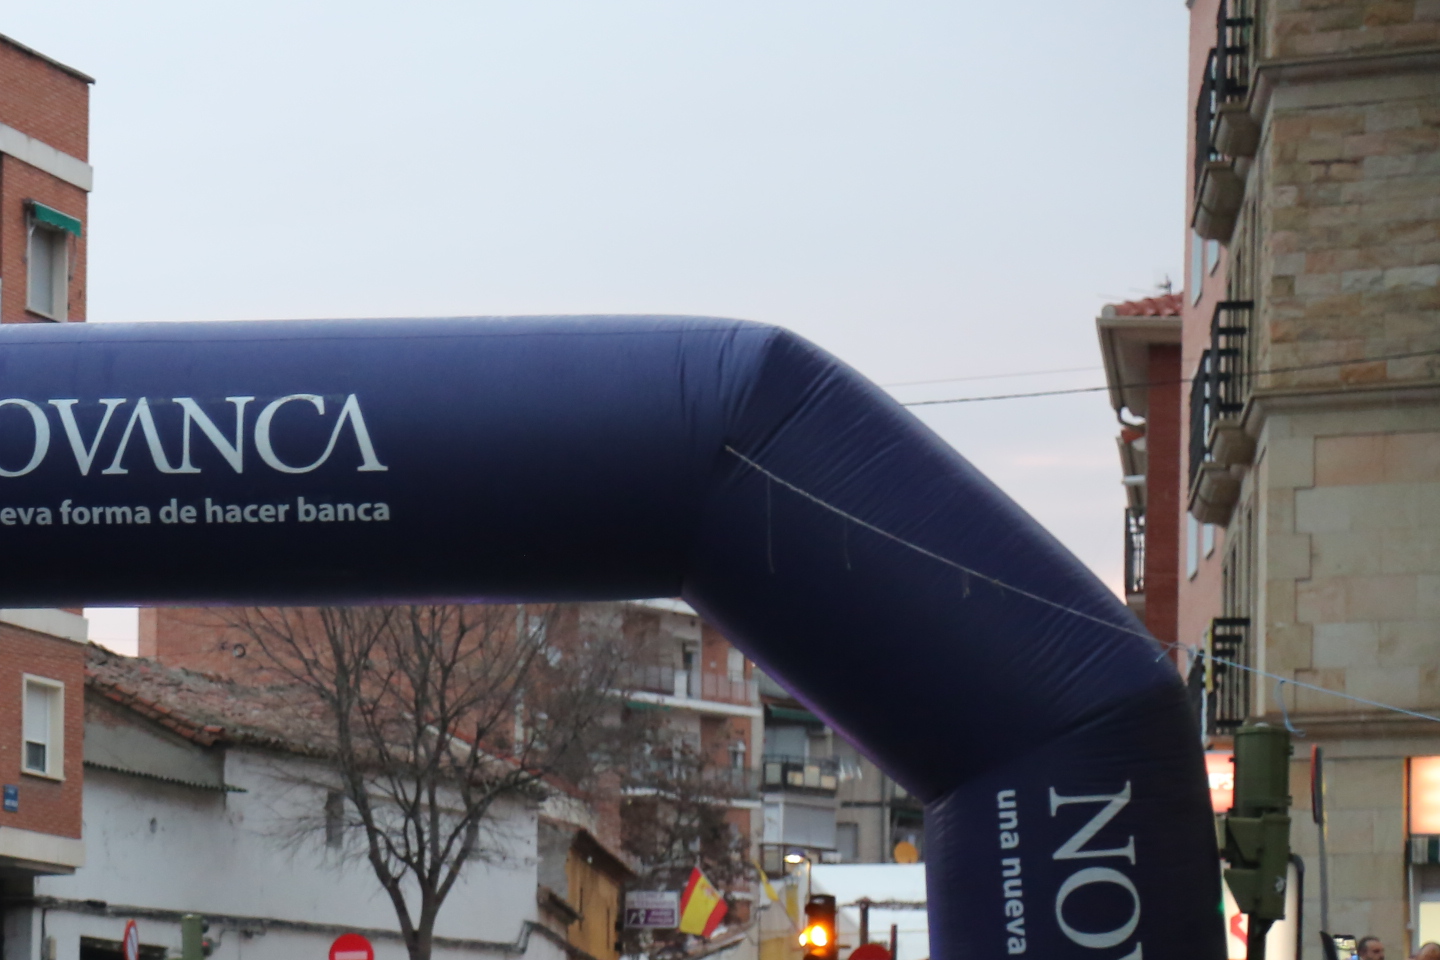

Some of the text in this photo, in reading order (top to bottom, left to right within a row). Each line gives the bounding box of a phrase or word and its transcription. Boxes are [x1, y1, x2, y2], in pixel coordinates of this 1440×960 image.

[60, 499, 151, 525] forma
[159, 498, 197, 524] de
[205, 498, 289, 524] hacer
[298, 496, 390, 523] banca
[997, 790, 1019, 849] una
[1002, 858, 1027, 954] nueva
